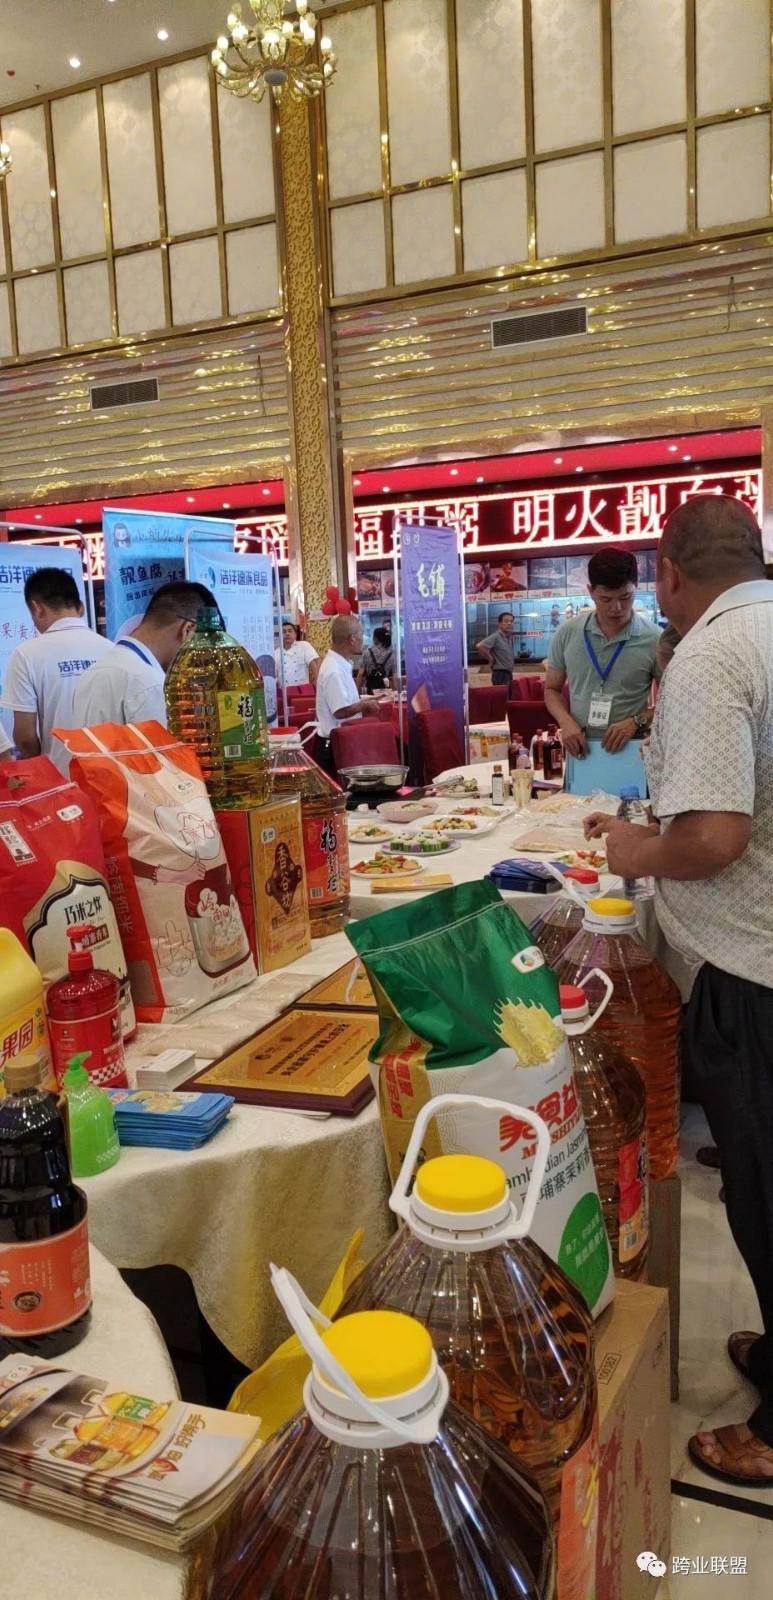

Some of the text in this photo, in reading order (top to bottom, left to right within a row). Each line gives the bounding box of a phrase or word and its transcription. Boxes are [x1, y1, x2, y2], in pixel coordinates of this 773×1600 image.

[220, 569, 269, 586] 洁洋速冻食品
[57, 659, 97, 672] 洁洋速
